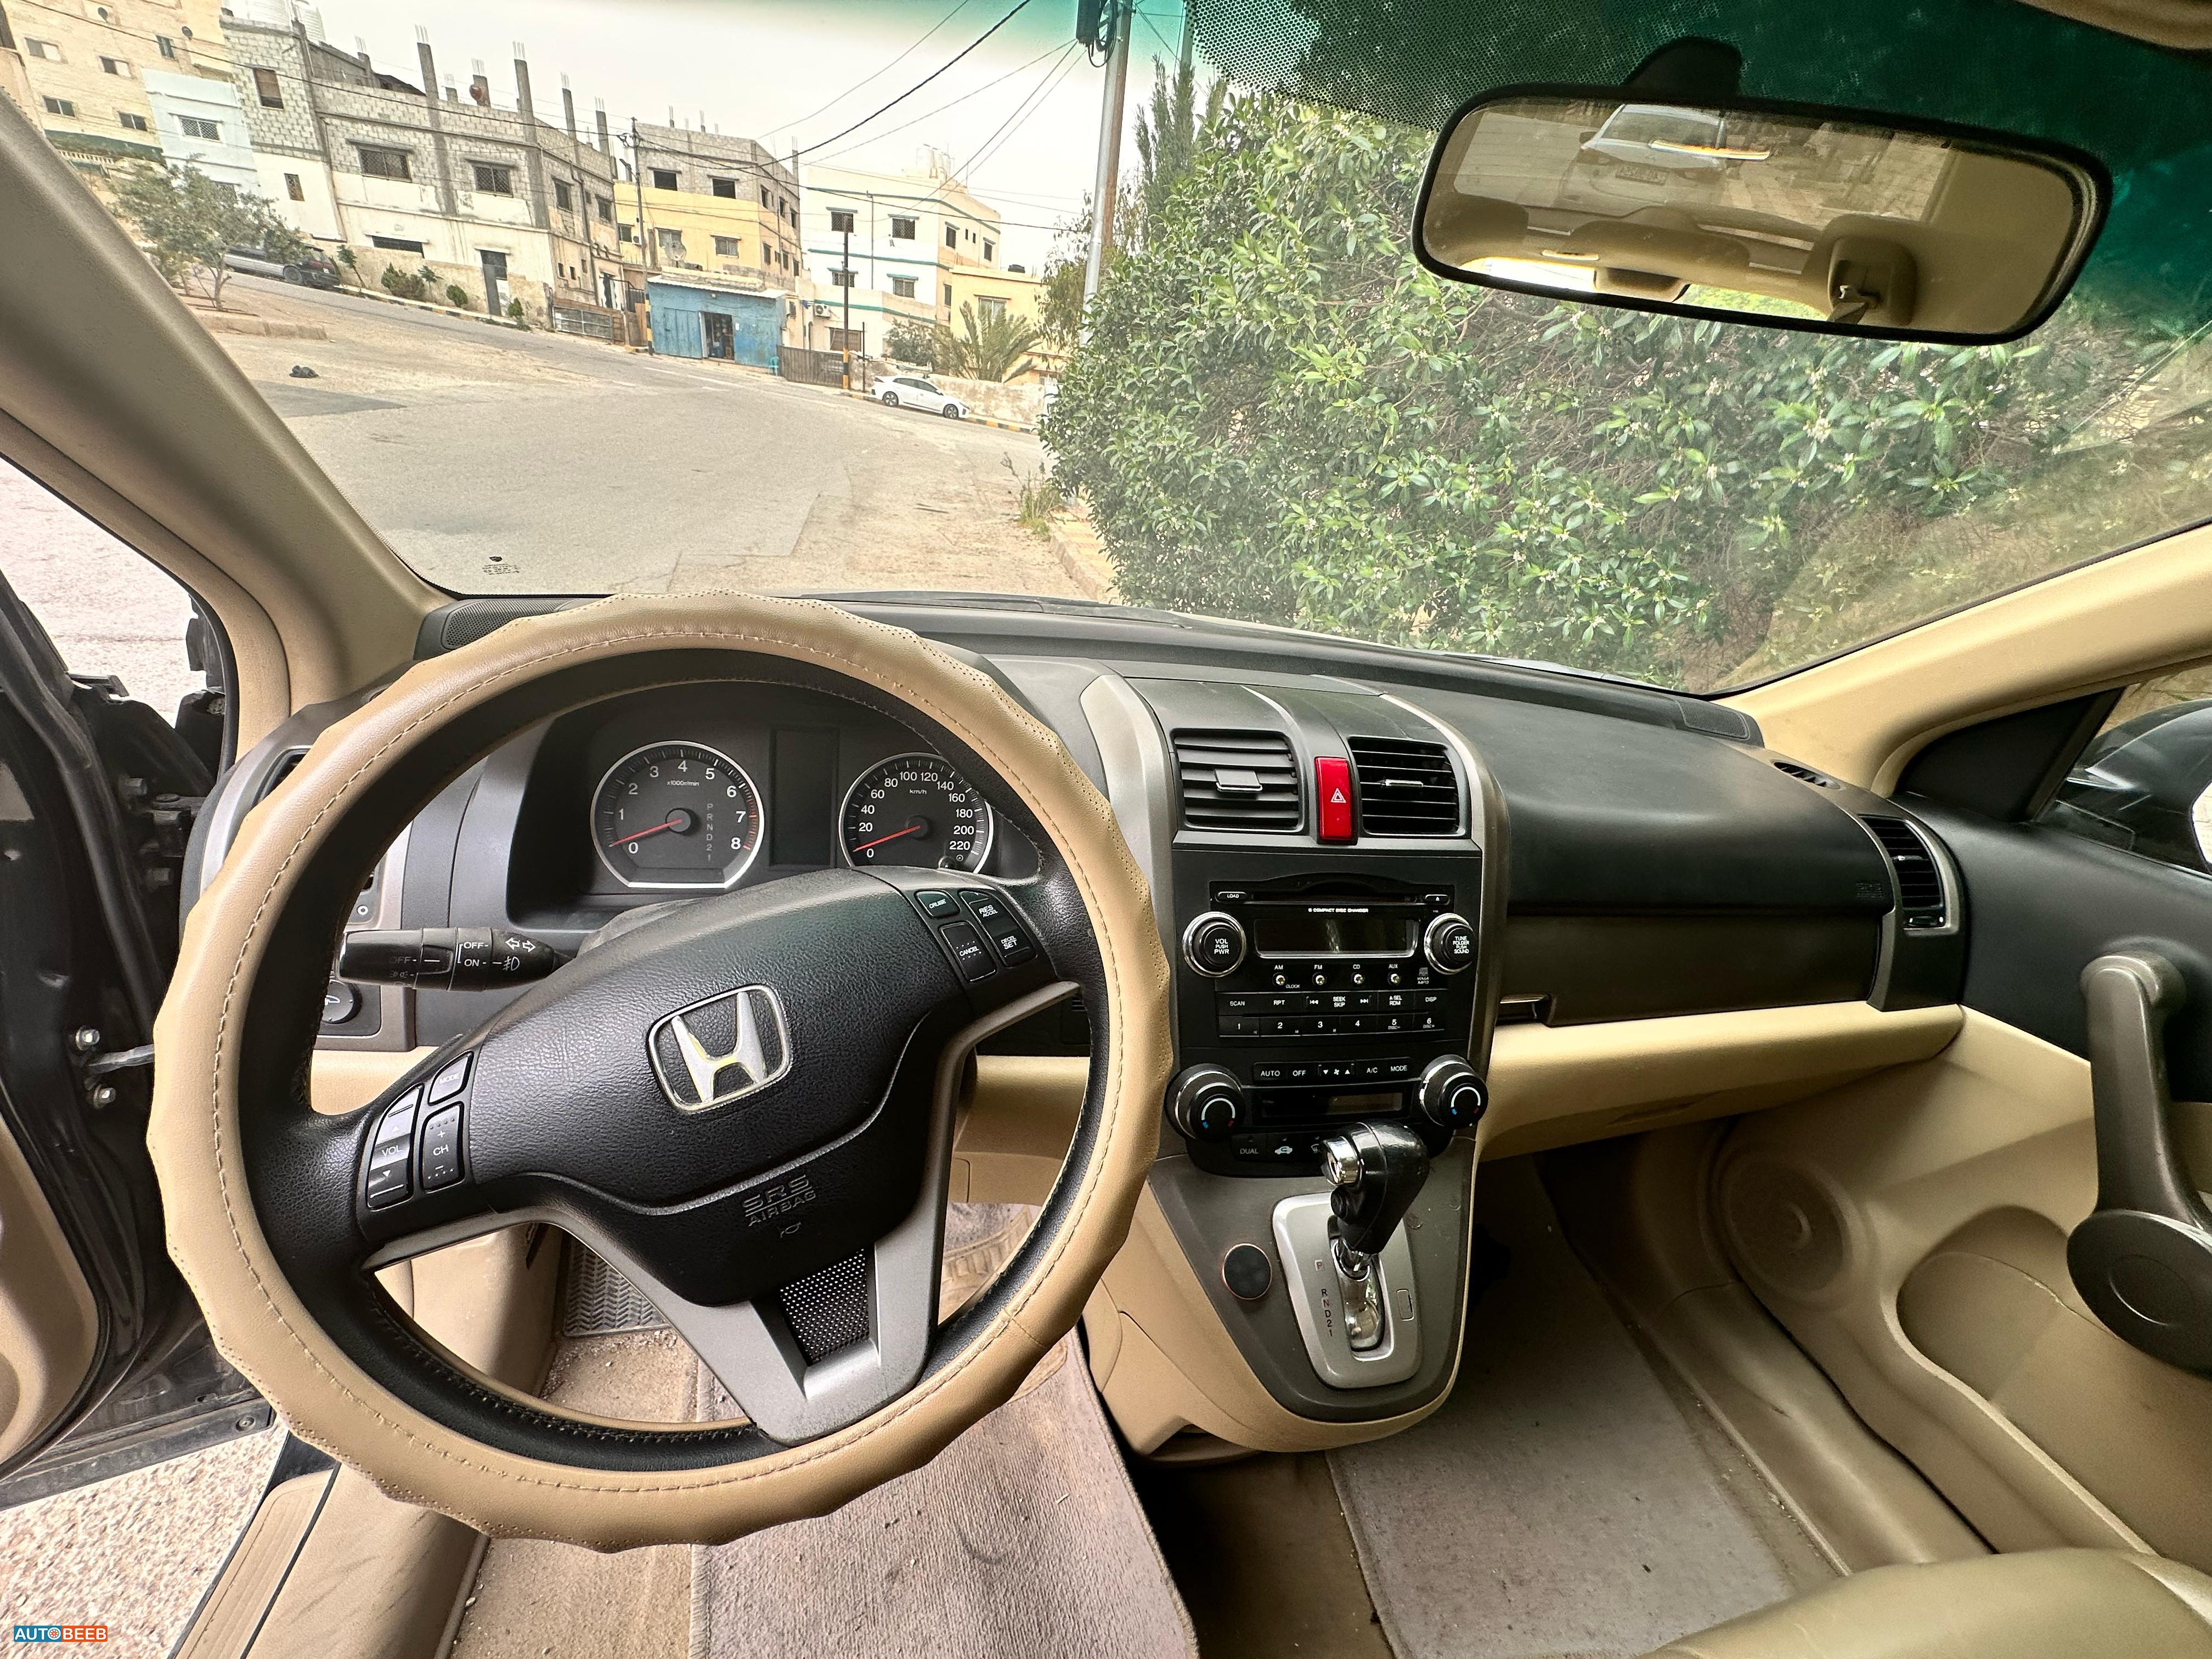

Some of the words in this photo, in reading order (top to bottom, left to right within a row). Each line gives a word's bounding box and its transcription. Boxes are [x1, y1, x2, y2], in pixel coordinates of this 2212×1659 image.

[678, 760, 687, 772] 4
[650, 766, 659, 778] 3
[706, 768, 715, 780] 5
[900, 771, 917, 781] 100
[921, 772, 938, 782] 120
[884, 778, 898, 787] 80
[937, 781, 954, 791] 140
[629, 783, 638, 794] 2
[727, 786, 737, 797] 6
[871, 789, 884, 799] 60
[949, 793, 966, 803] 160
[619, 809, 624, 820] 1
[861, 805, 874, 814] 40
[956, 809, 973, 818] 180
[736, 811, 746, 823] 7
[859, 822, 873, 832] 20
[953, 826, 974, 835] 200
[628, 842, 639, 854] 0
[731, 837, 741, 850] 8
[949, 841, 970, 850] 220
[866, 849, 874, 858] 0
[929, 899, 947, 909] CRUISE
[979, 905, 994, 914] RES
[983, 910, 998, 918] ACCEL
[1001, 935, 1016, 944] DECEL
[1003, 939, 1017, 949] SET
[960, 946, 980, 957] CANCEL
[439, 1073, 460, 1084] MODE
[381, 1145, 403, 1156] VOL
[432, 1144, 449, 1156] CH
[748, 1190, 816, 1227] AIRBAG
